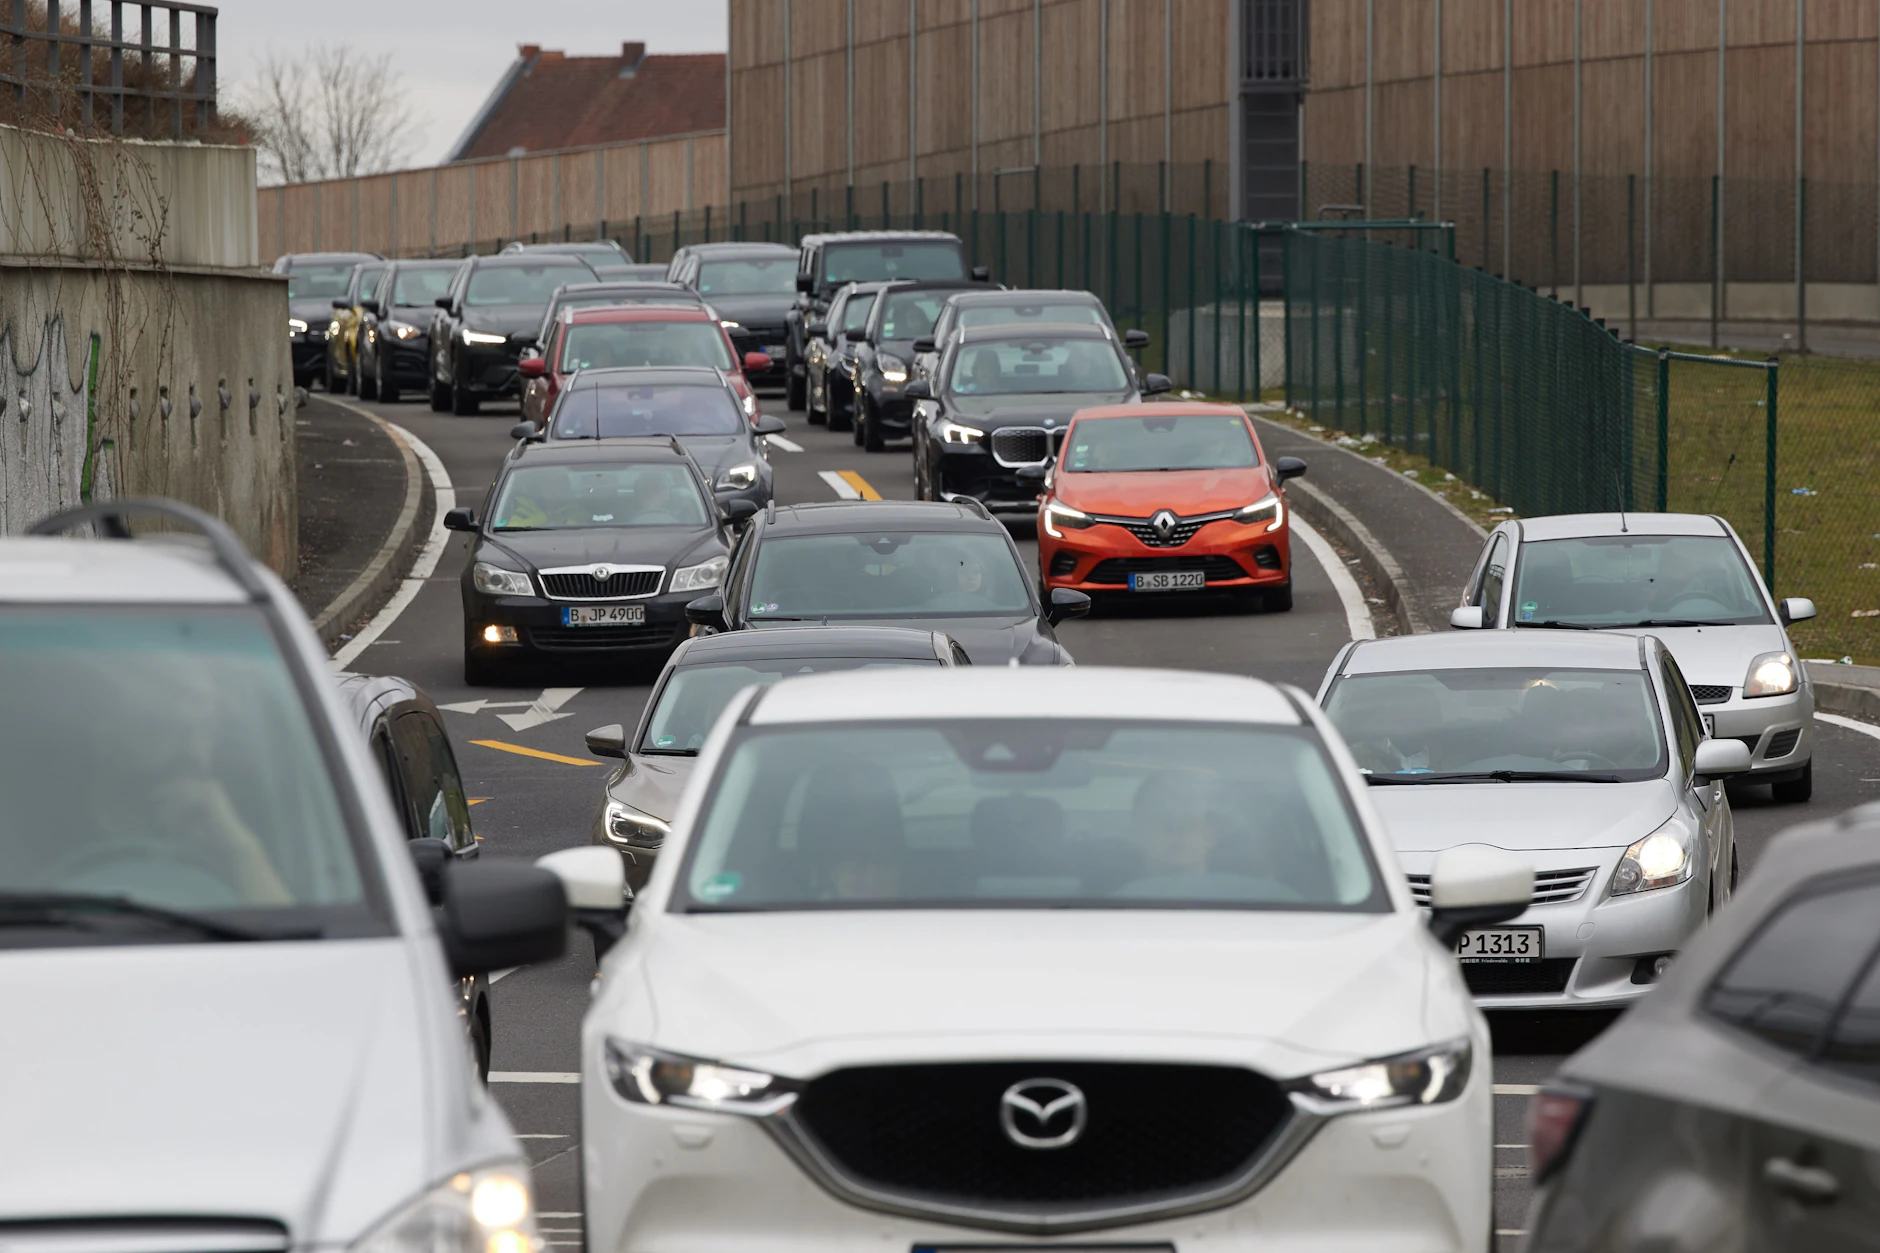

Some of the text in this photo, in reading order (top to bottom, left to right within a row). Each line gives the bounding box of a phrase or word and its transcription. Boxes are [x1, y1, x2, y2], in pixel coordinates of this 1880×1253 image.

[1136, 573, 1203, 588] B SB 1220
[571, 608, 643, 621] B JP 4900
[1476, 934, 1529, 954] 1313
